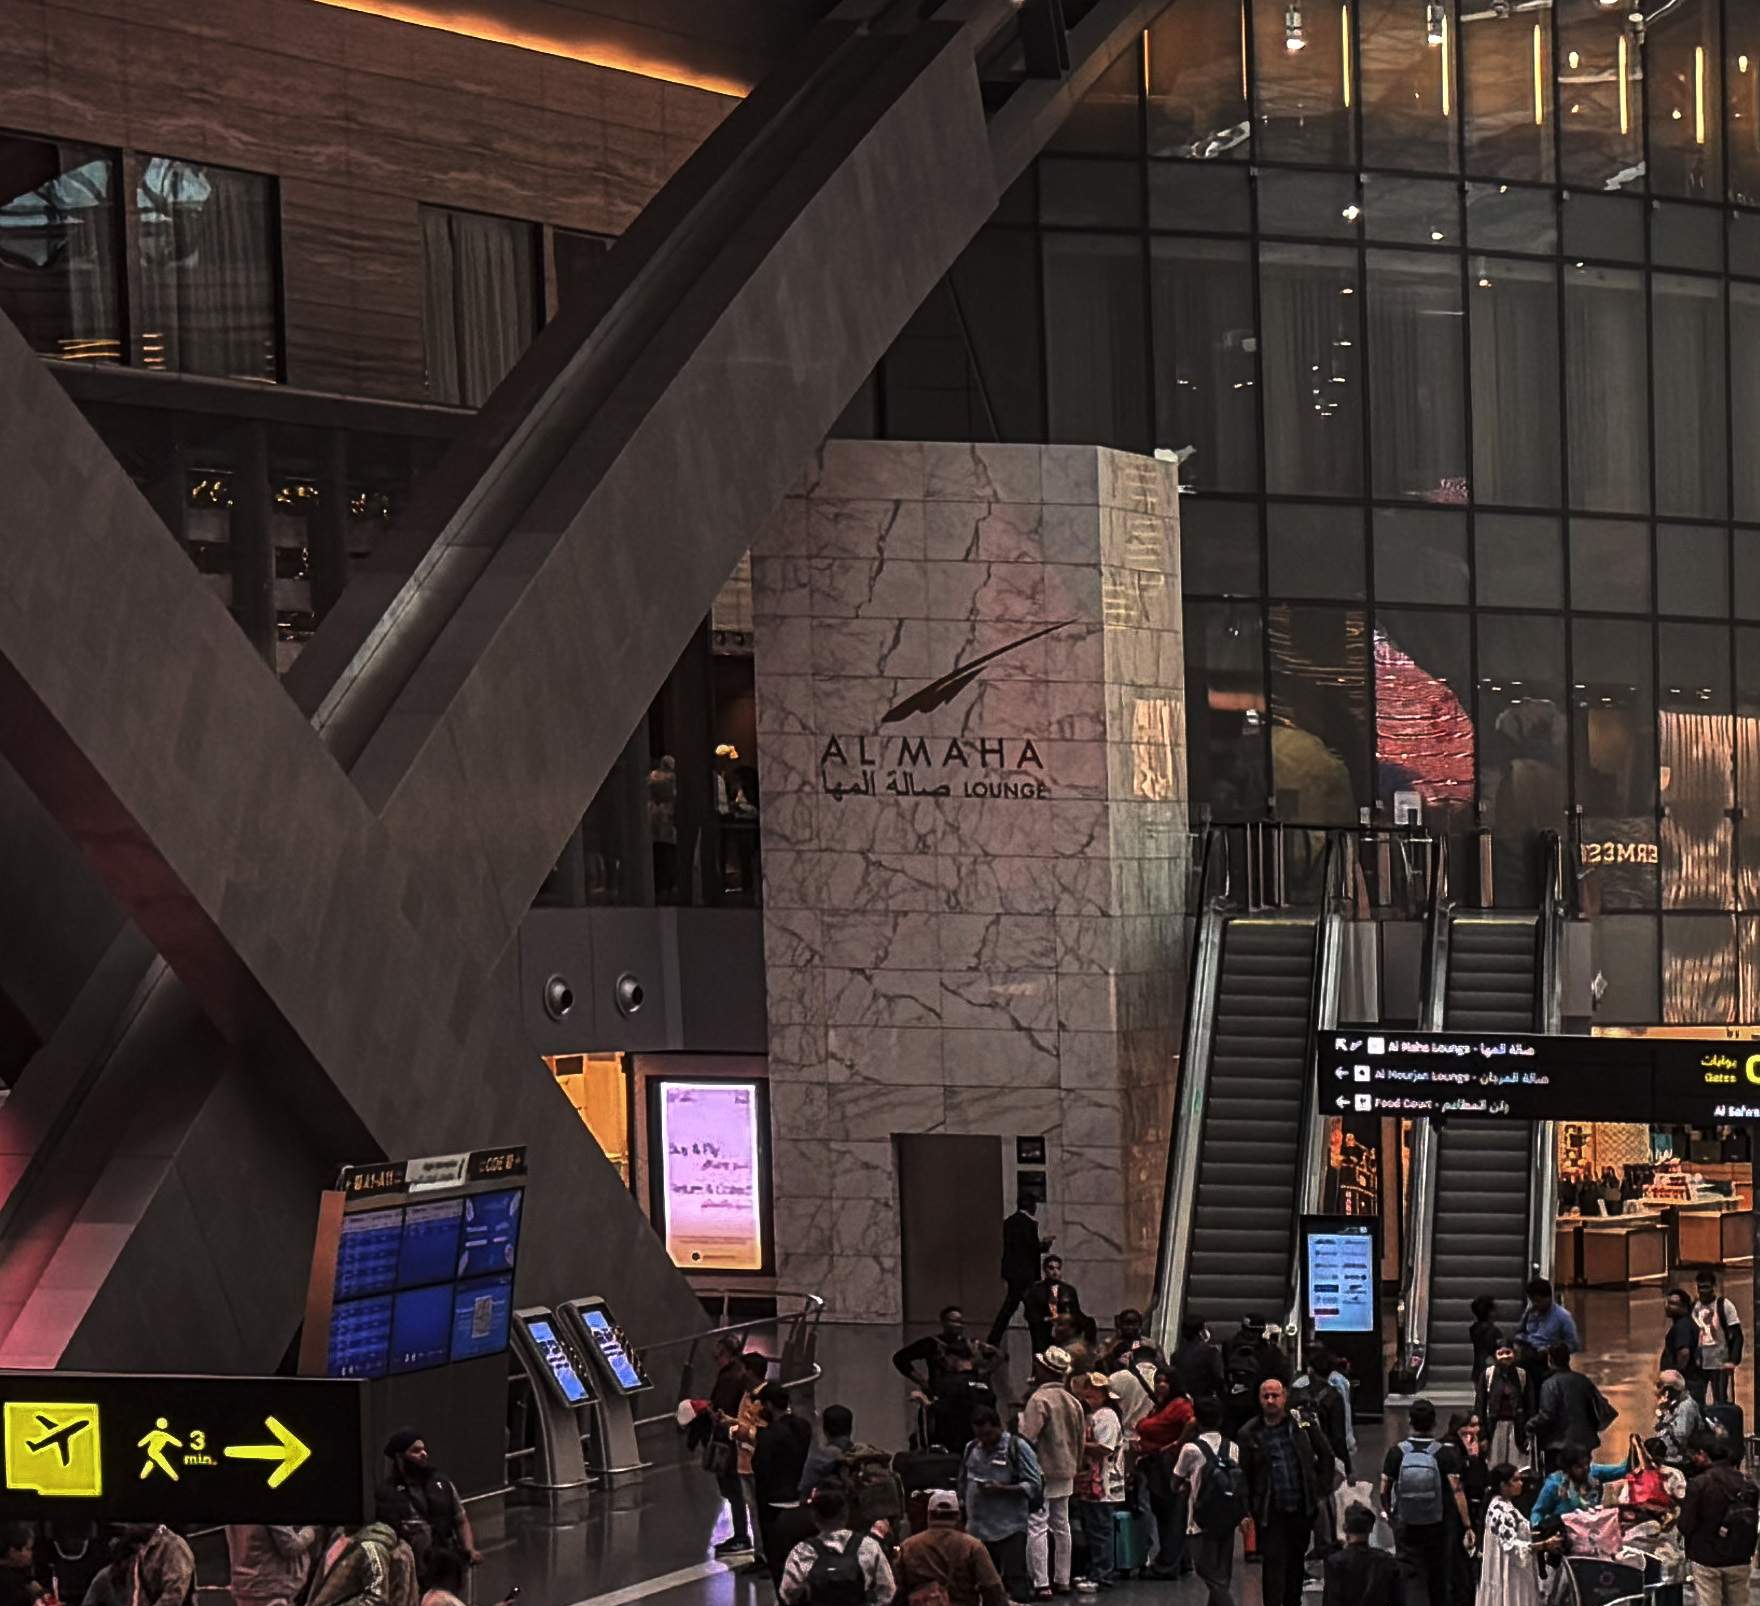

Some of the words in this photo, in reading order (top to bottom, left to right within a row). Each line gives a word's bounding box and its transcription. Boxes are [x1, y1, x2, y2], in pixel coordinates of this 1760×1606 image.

[821, 735, 876, 766] AL
[898, 736, 1044, 769] MAHA
[822, 768, 877, 801] المها
[887, 769, 951, 797] صالة
[964, 781, 1049, 799] LOUNGE
[190, 1430, 206, 1451] 3
[184, 1453, 218, 1466] min.
